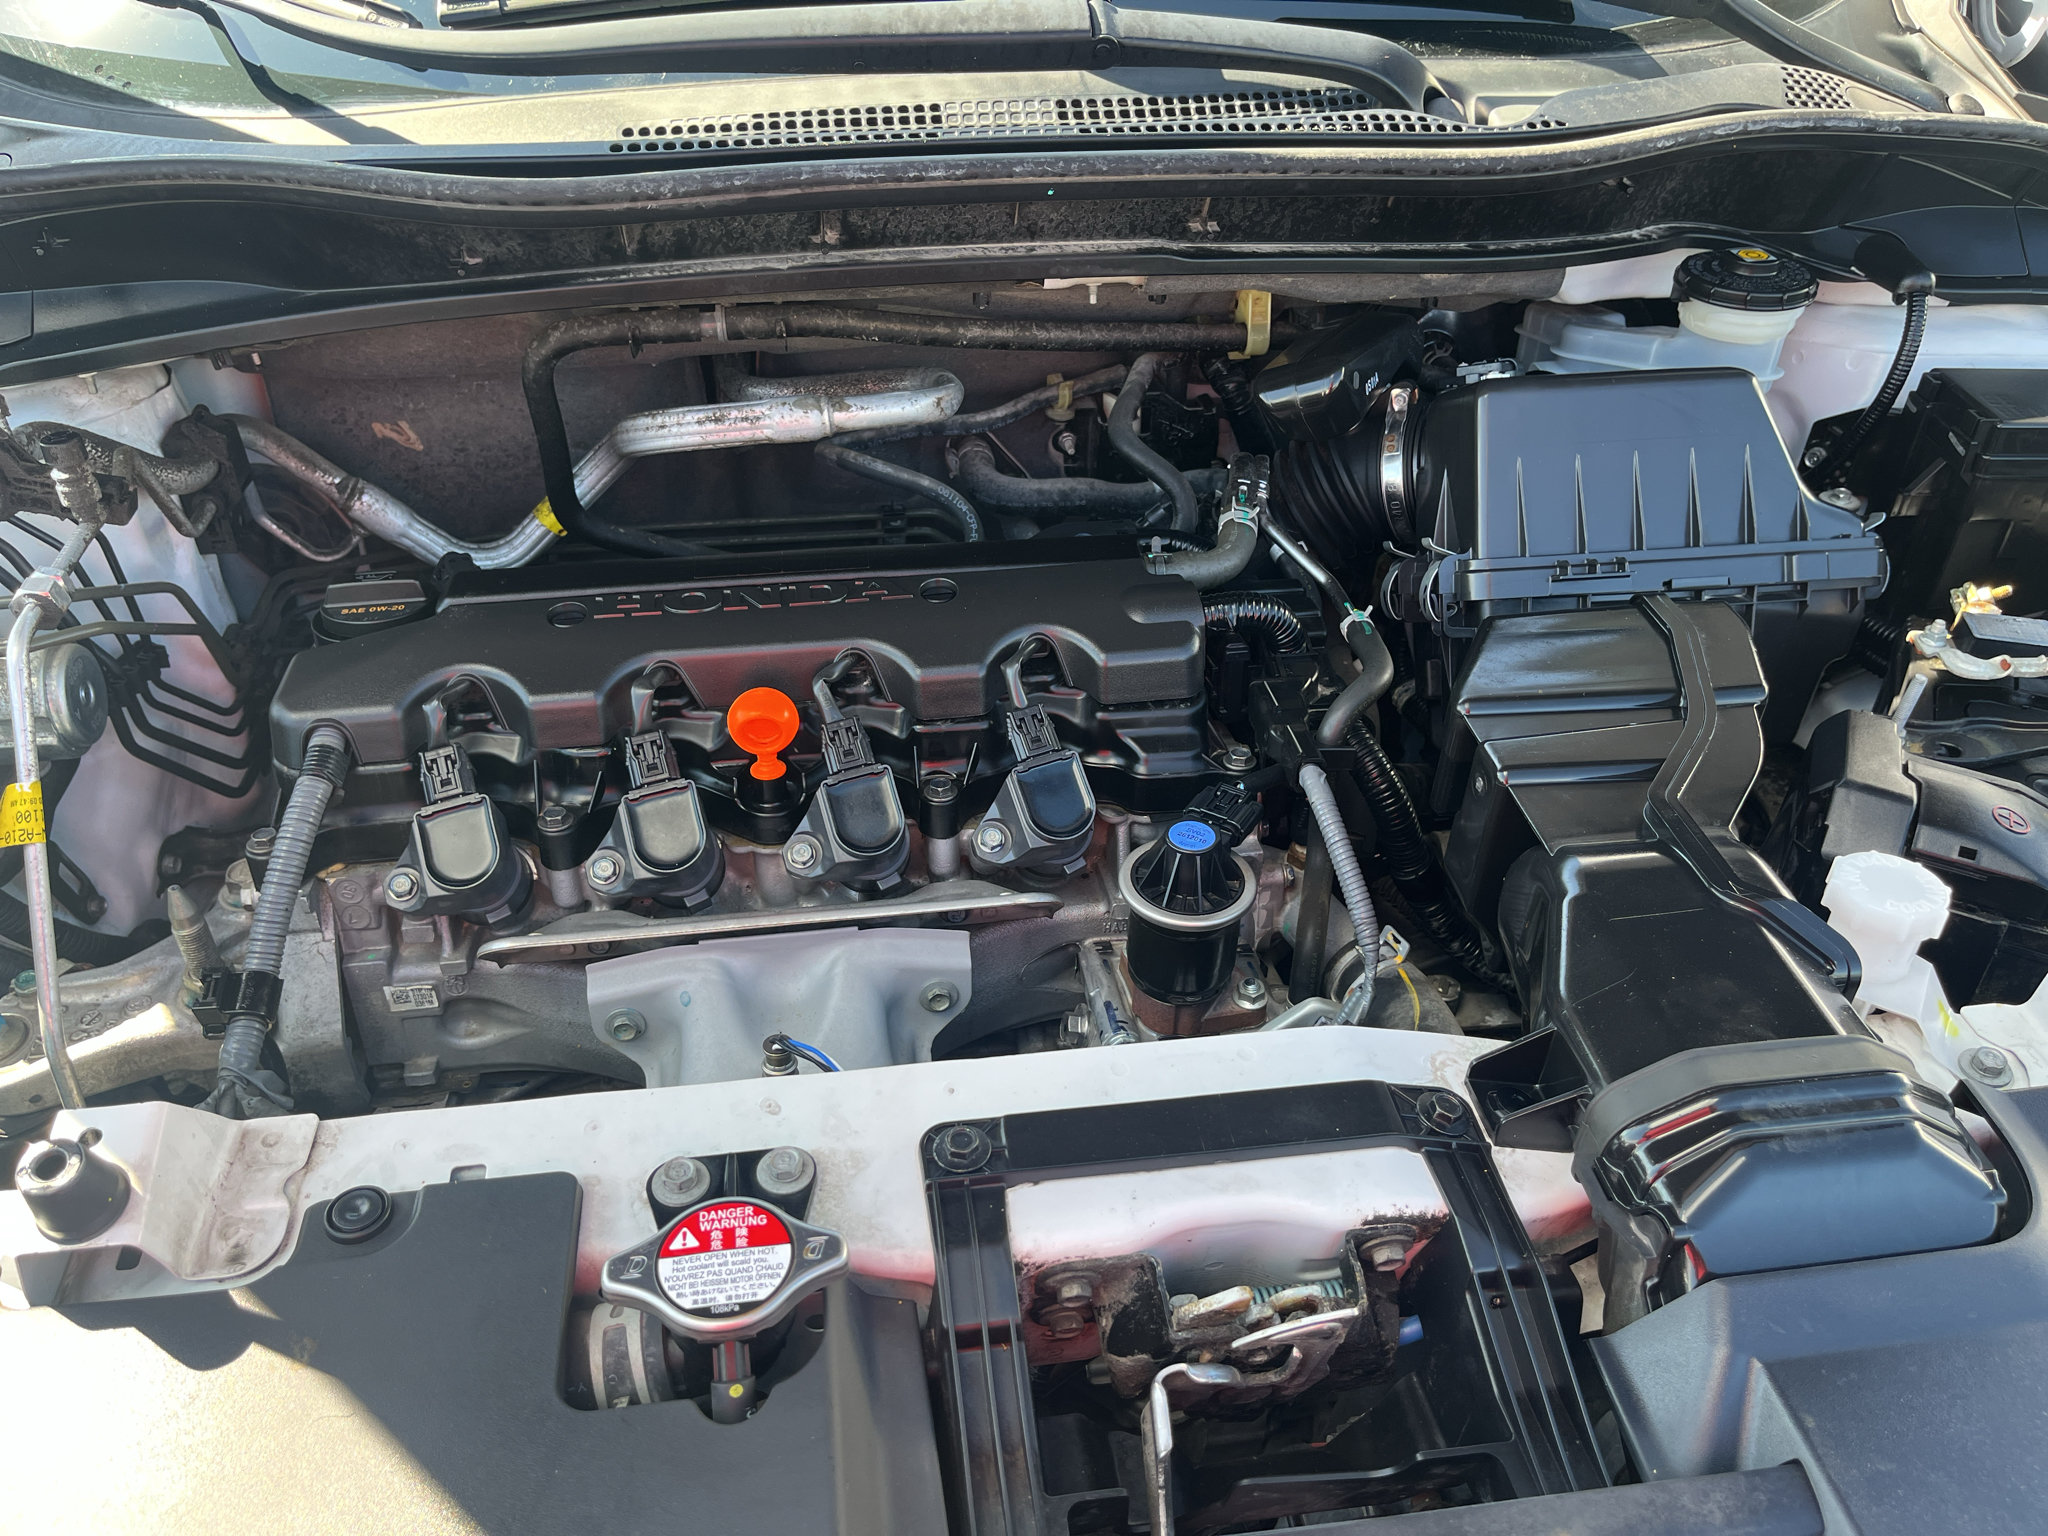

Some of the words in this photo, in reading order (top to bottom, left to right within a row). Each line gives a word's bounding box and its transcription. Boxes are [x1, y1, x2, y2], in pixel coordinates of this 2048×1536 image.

[593, 580, 915, 620] HONDA
[340, 607, 366, 615] SAE
[368, 604, 405, 613] 0W-20
[699, 1206, 754, 1222] DANGER
[699, 1214, 768, 1232] WARNUNG
[671, 1264, 686, 1274] Hot
[687, 1261, 716, 1272] coolant
[716, 1260, 730, 1268] will
[730, 1257, 751, 1267] scald
[752, 1256, 769, 1266] you.
[672, 1254, 702, 1266] NEVER
[703, 1251, 728, 1262] OPEN
[729, 1248, 756, 1259] WHEN
[757, 1246, 779, 1256] HOT.
[664, 1271, 705, 1284] N'OUVREZ
[706, 1268, 723, 1278] PAS
[724, 1265, 754, 1277] QUAND
[667, 1283, 687, 1292] NICHT
[688, 1280, 699, 1289] BEI
[700, 1277, 729, 1288] HEISSEM
[729, 1274, 754, 1285] MOTOR
[710, 1303, 740, 1314] 108kPa
